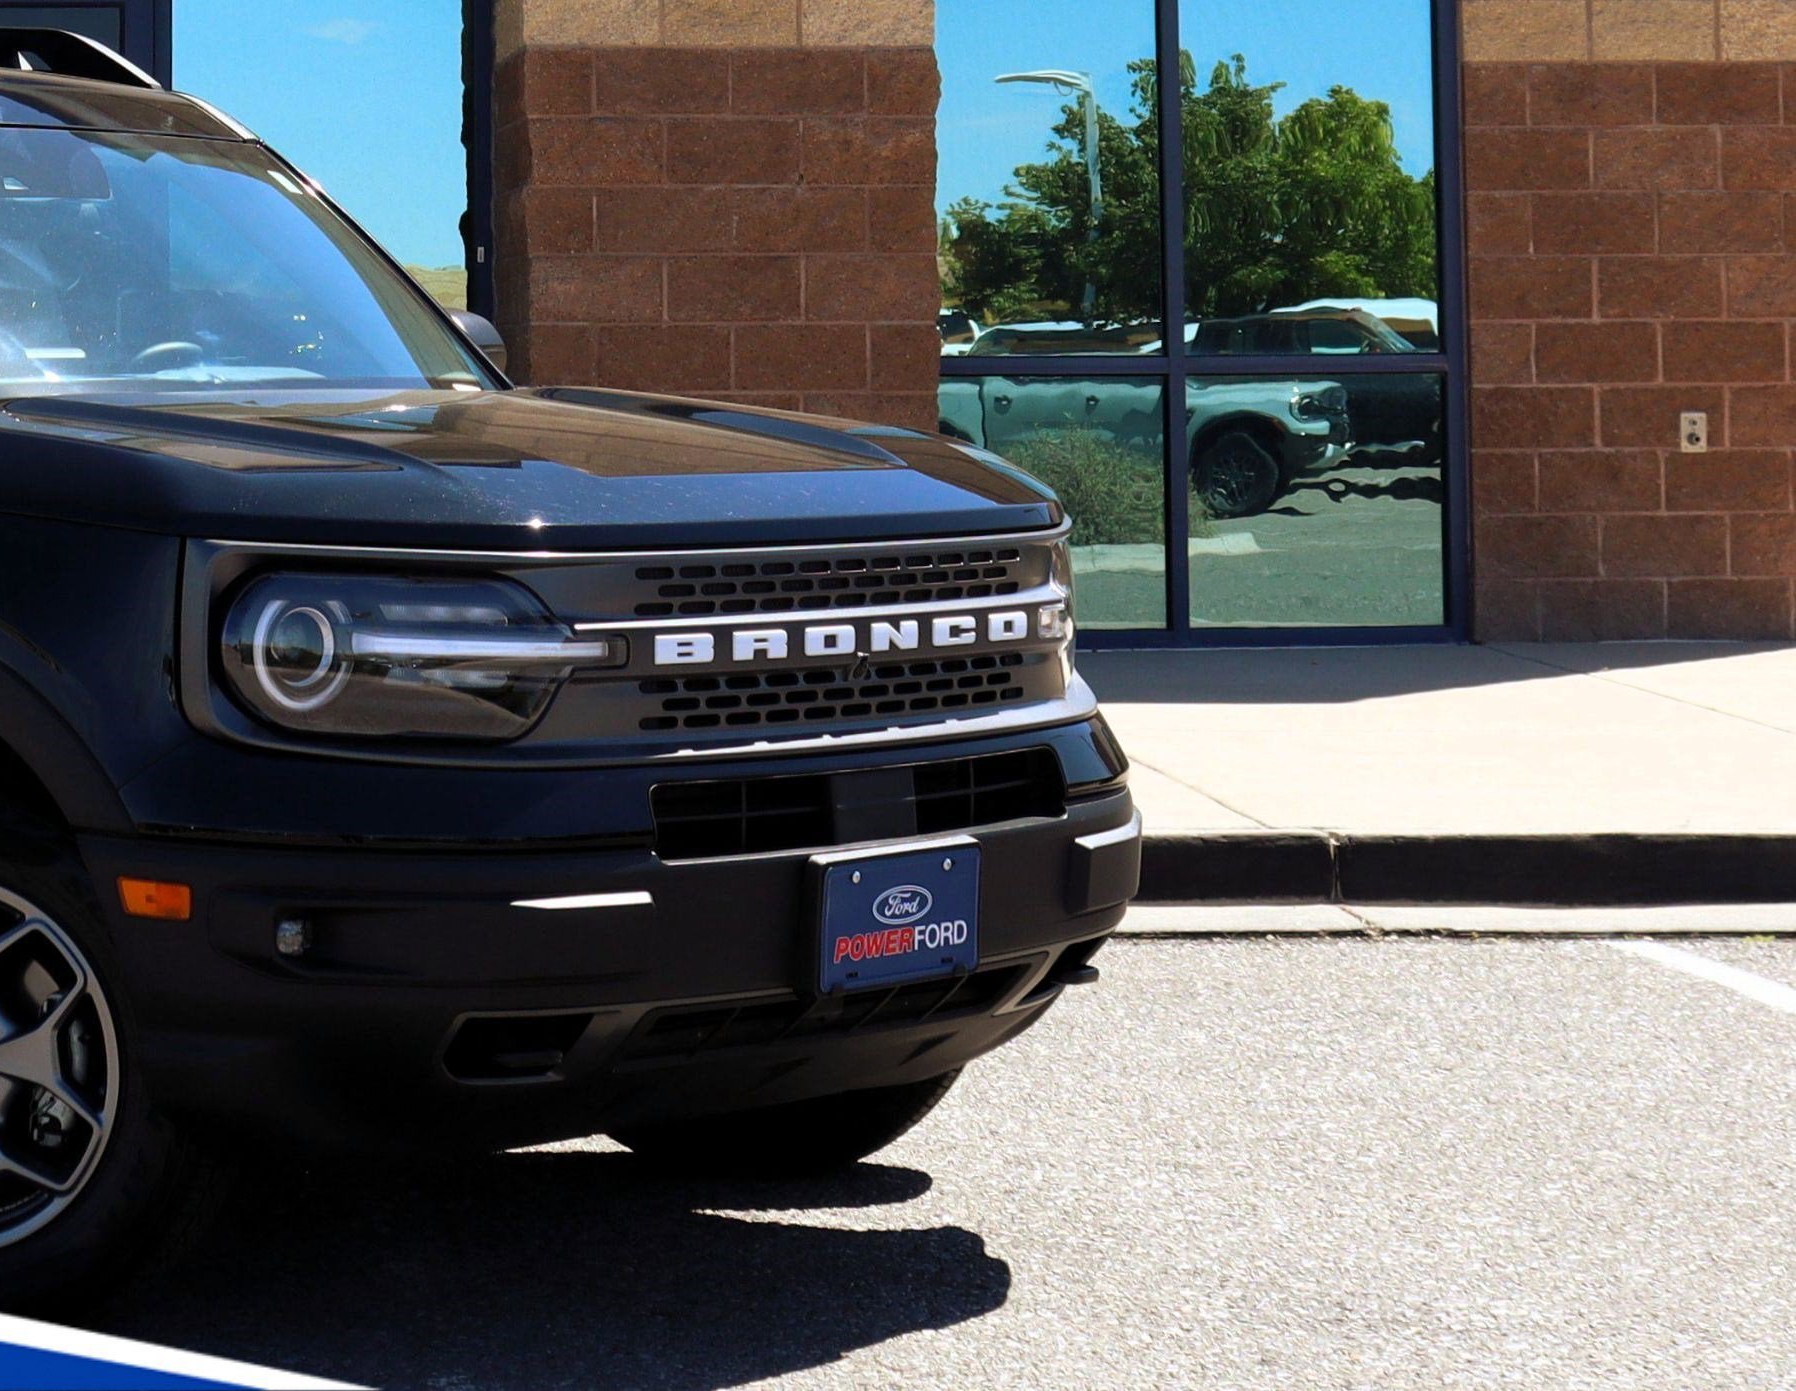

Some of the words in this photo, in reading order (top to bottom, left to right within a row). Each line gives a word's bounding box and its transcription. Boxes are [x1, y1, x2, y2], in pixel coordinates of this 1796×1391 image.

[654, 610, 1029, 666] BRONCO
[884, 892, 919, 918] Ford
[833, 919, 968, 964] POWERFORD
